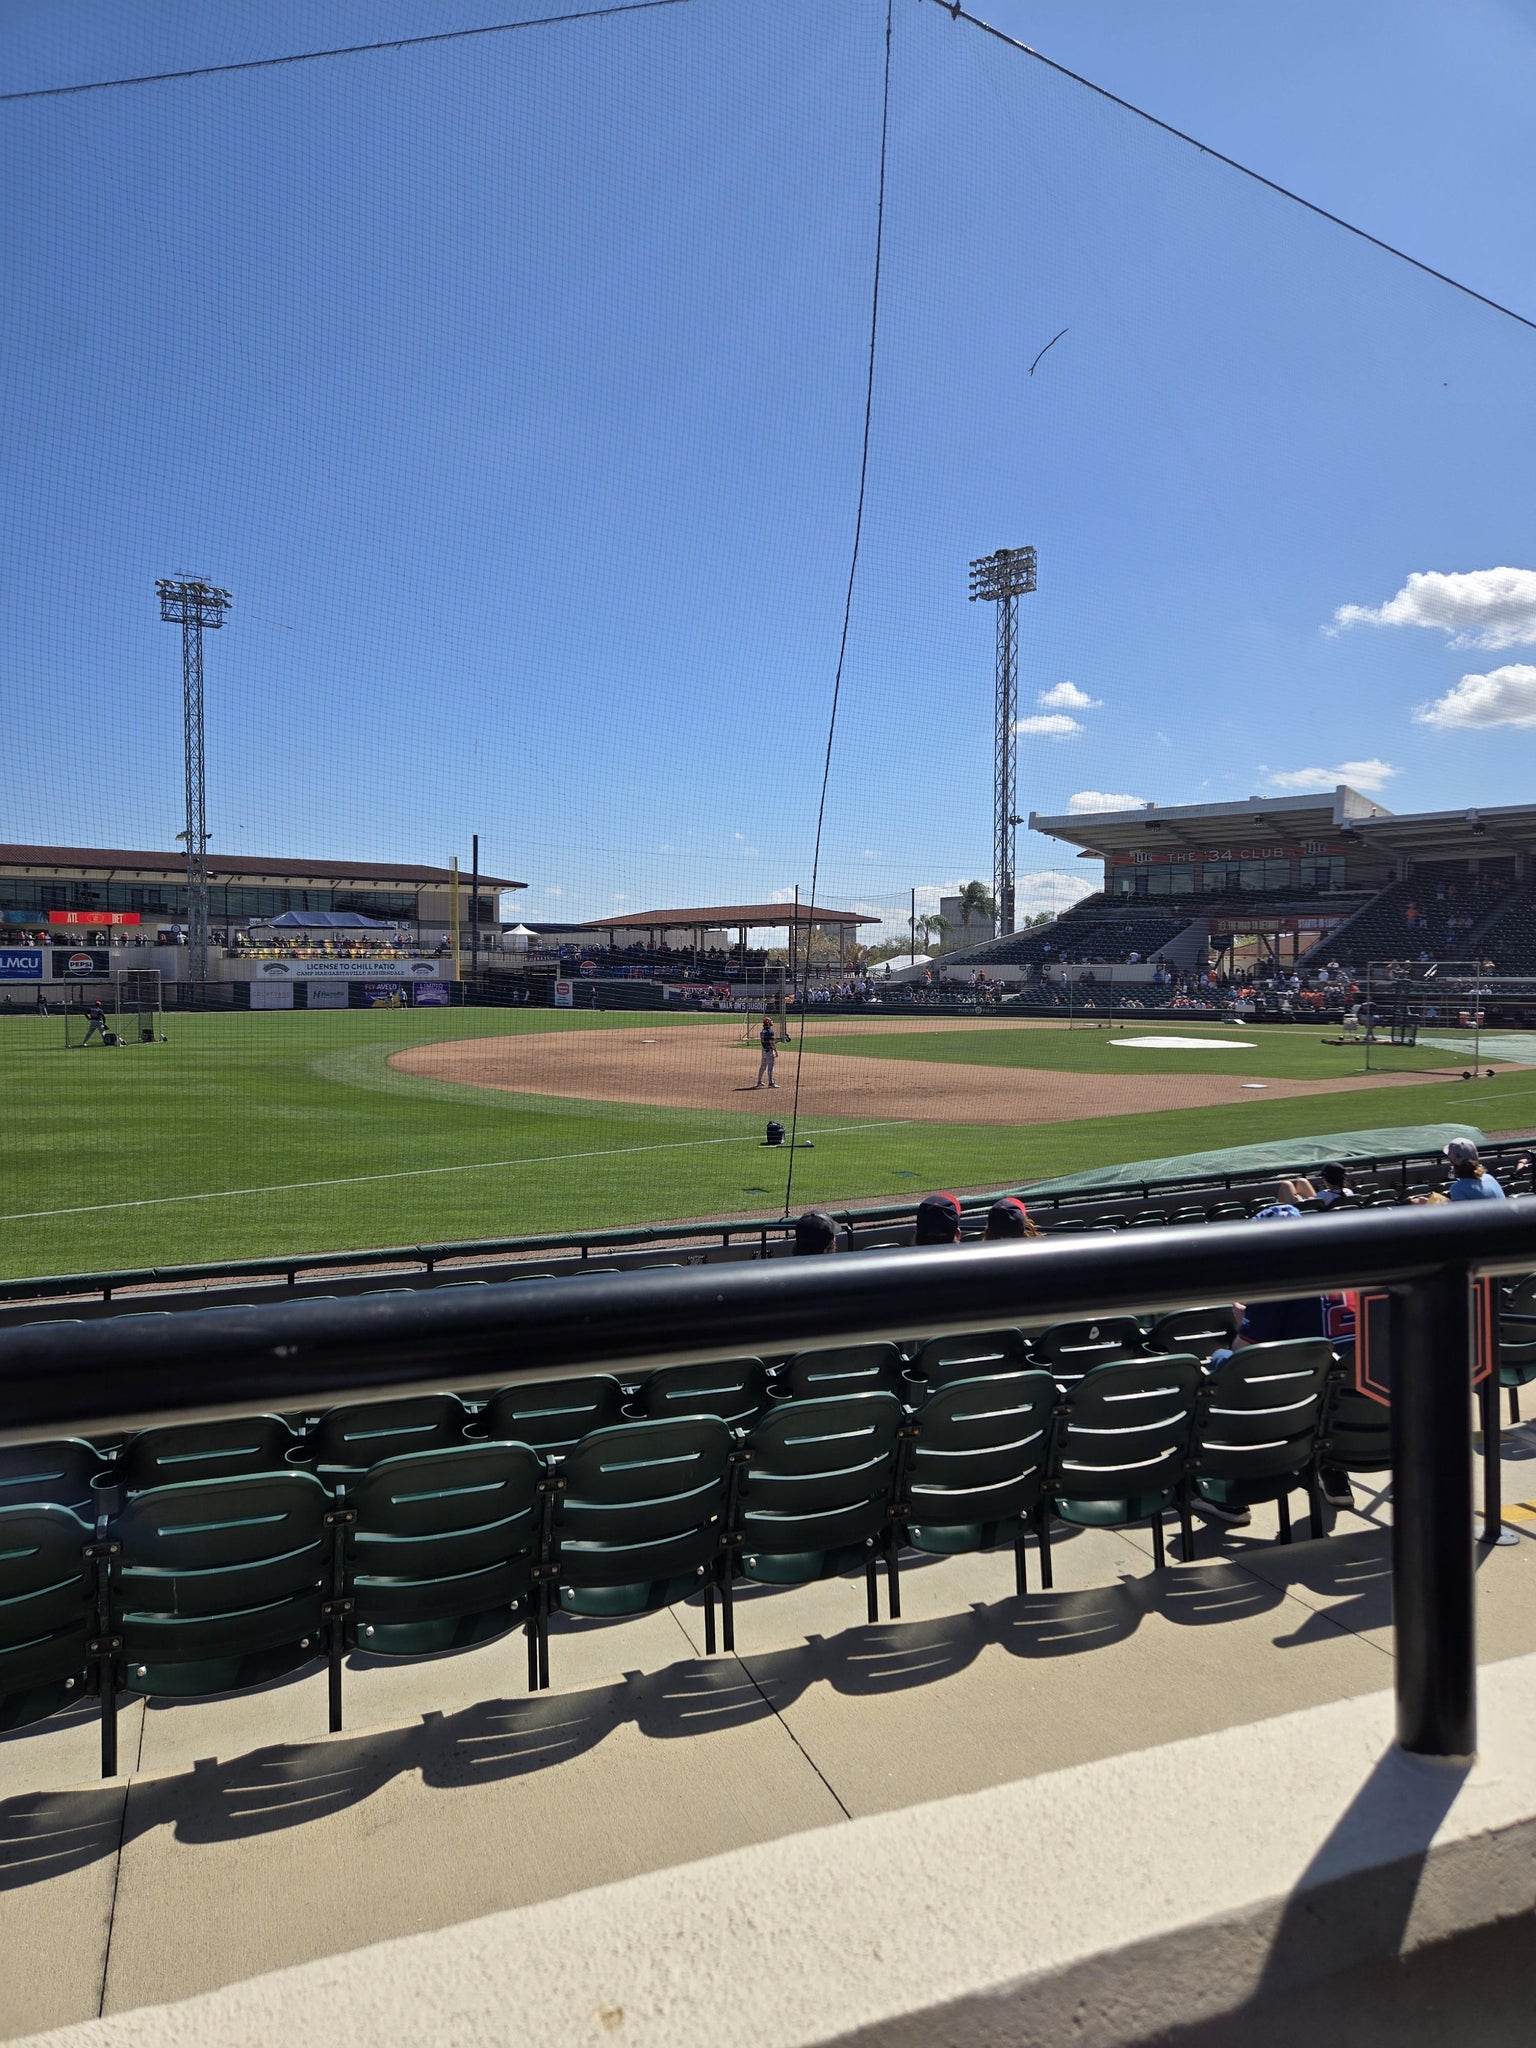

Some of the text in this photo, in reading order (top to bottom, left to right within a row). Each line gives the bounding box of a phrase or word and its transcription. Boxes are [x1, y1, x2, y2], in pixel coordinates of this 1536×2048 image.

[1167, 852, 1196, 863] THE
[1203, 849, 1233, 862] '34
[1240, 847, 1284, 859] CLUB
[67, 911, 79, 923] ATL
[0, 957, 39, 968] LMCU
